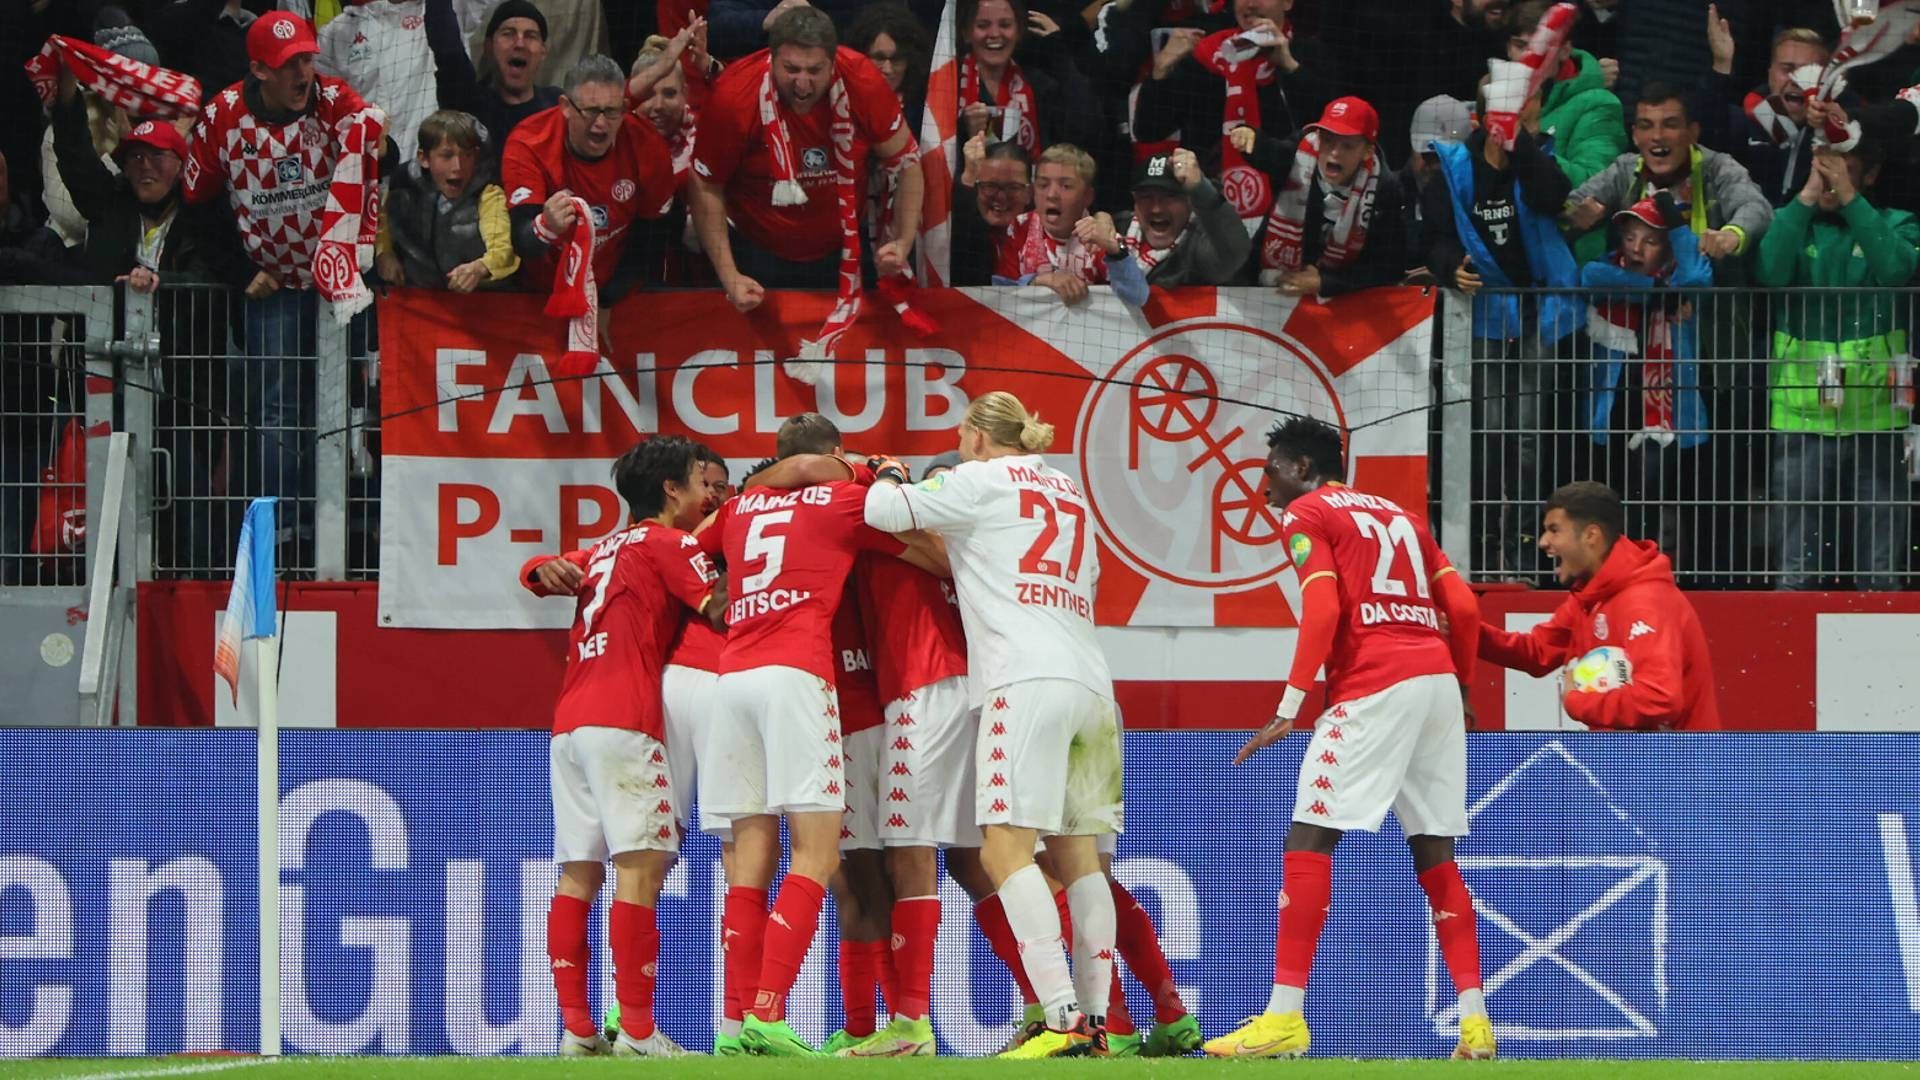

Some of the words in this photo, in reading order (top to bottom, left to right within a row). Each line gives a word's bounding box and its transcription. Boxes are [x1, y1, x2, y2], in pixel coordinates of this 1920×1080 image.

[435, 347, 969, 435] FANCLUB
[735, 490, 802, 515] MAINZ
[801, 485, 833, 506] 05
[1018, 488, 1086, 584] 27
[741, 509, 794, 595] 5
[1349, 510, 1430, 599] 21
[582, 554, 617, 638] 7
[1360, 602, 1392, 625] DA
[1389, 602, 1440, 631] COSTA
[841, 648, 872, 673] BA
